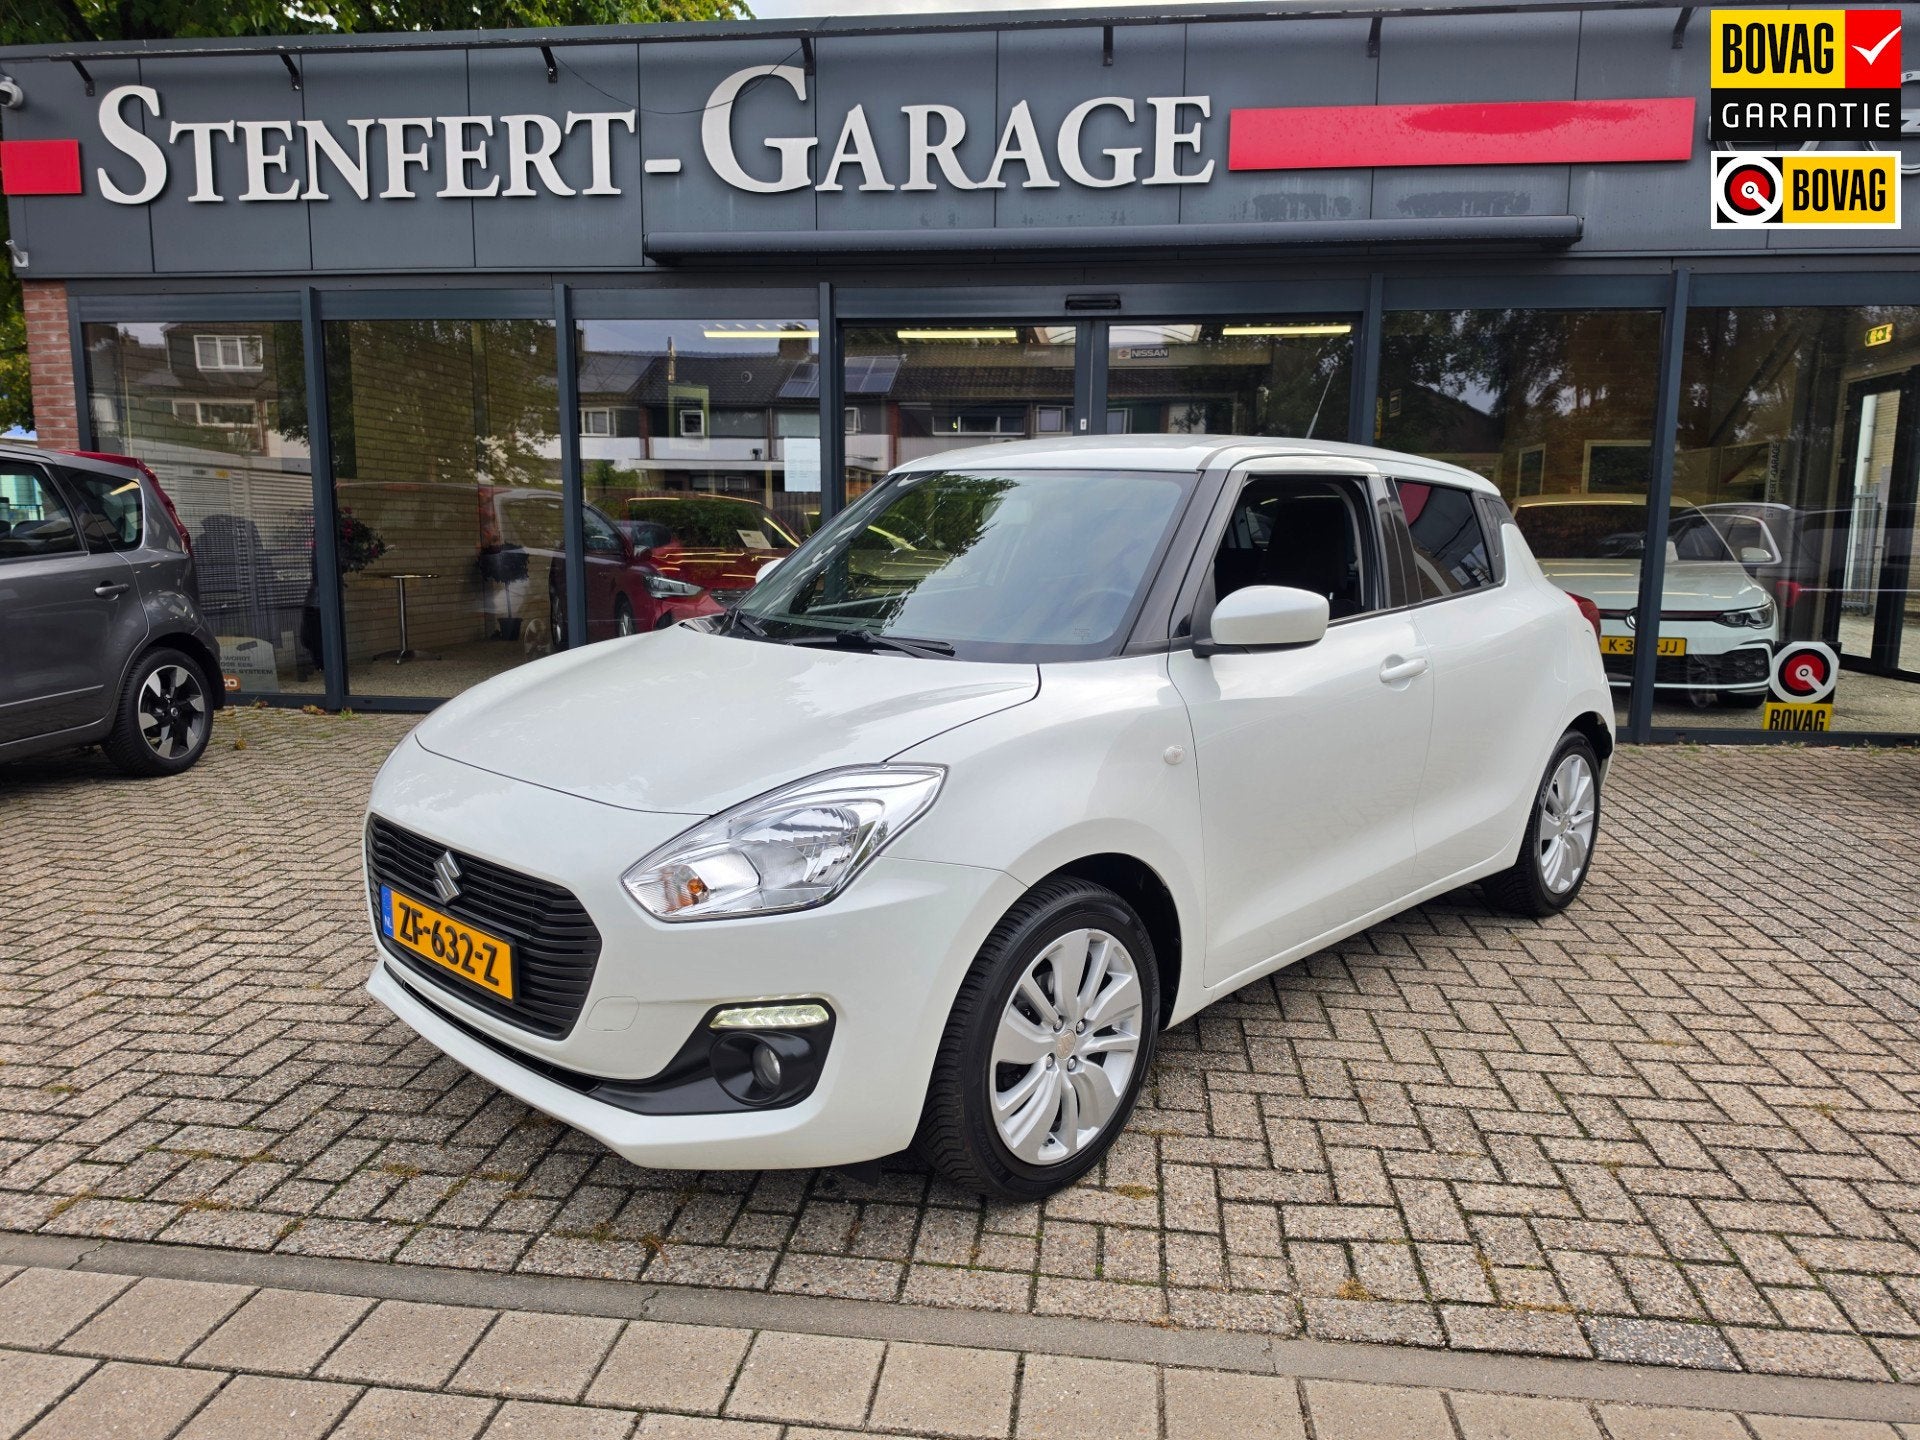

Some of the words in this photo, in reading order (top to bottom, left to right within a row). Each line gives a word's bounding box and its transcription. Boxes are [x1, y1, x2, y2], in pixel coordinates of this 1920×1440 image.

[1131, 349, 1168, 358] NISSAN
[1769, 709, 1826, 731] BOVAG
[398, 901, 499, 987] ZF-632-Z
